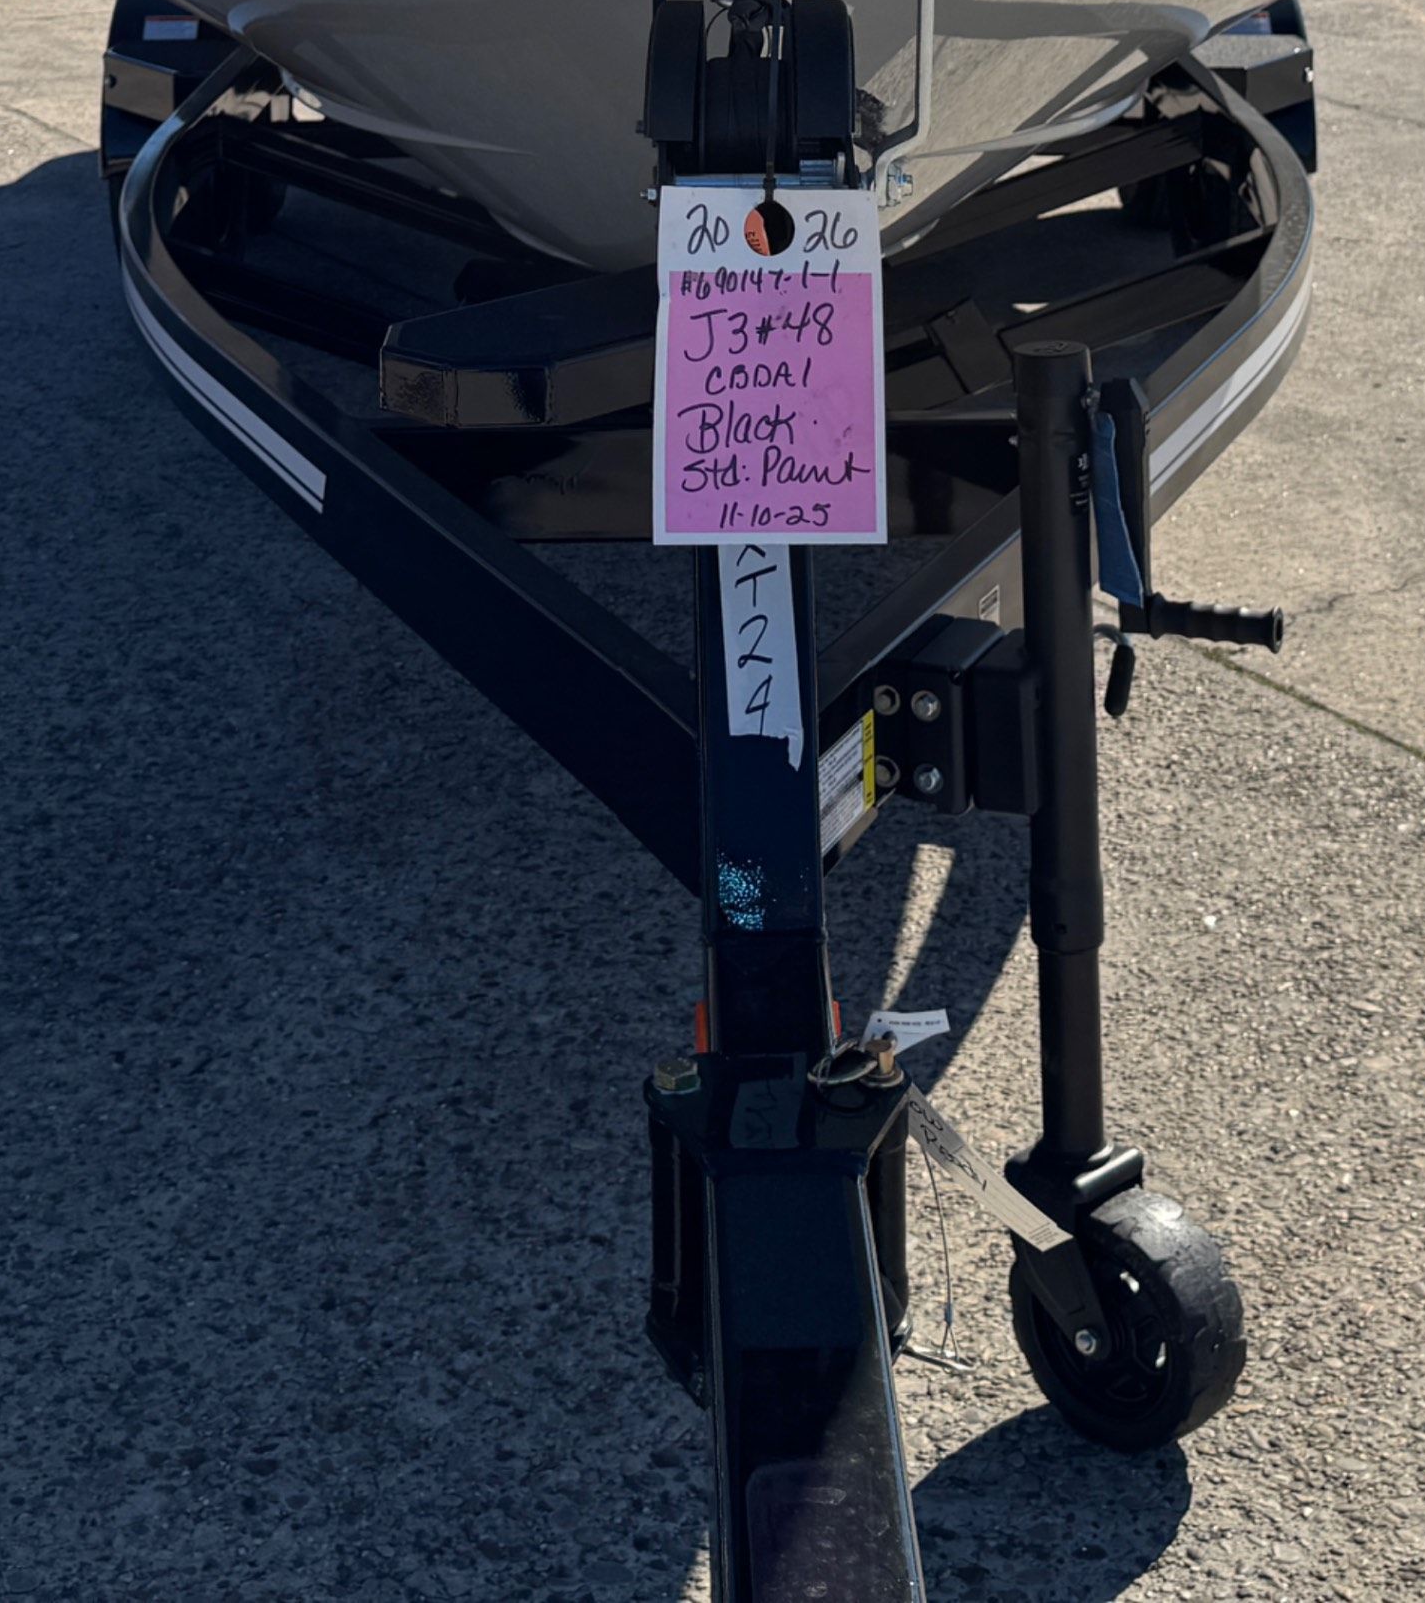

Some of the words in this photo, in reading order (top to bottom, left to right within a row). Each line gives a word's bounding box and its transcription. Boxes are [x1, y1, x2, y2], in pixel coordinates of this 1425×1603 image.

[686, 203, 730, 255] 20
[803, 209, 858, 253] 26
[677, 399, 796, 454] Black
[719, 500, 832, 529] 11-10-25
